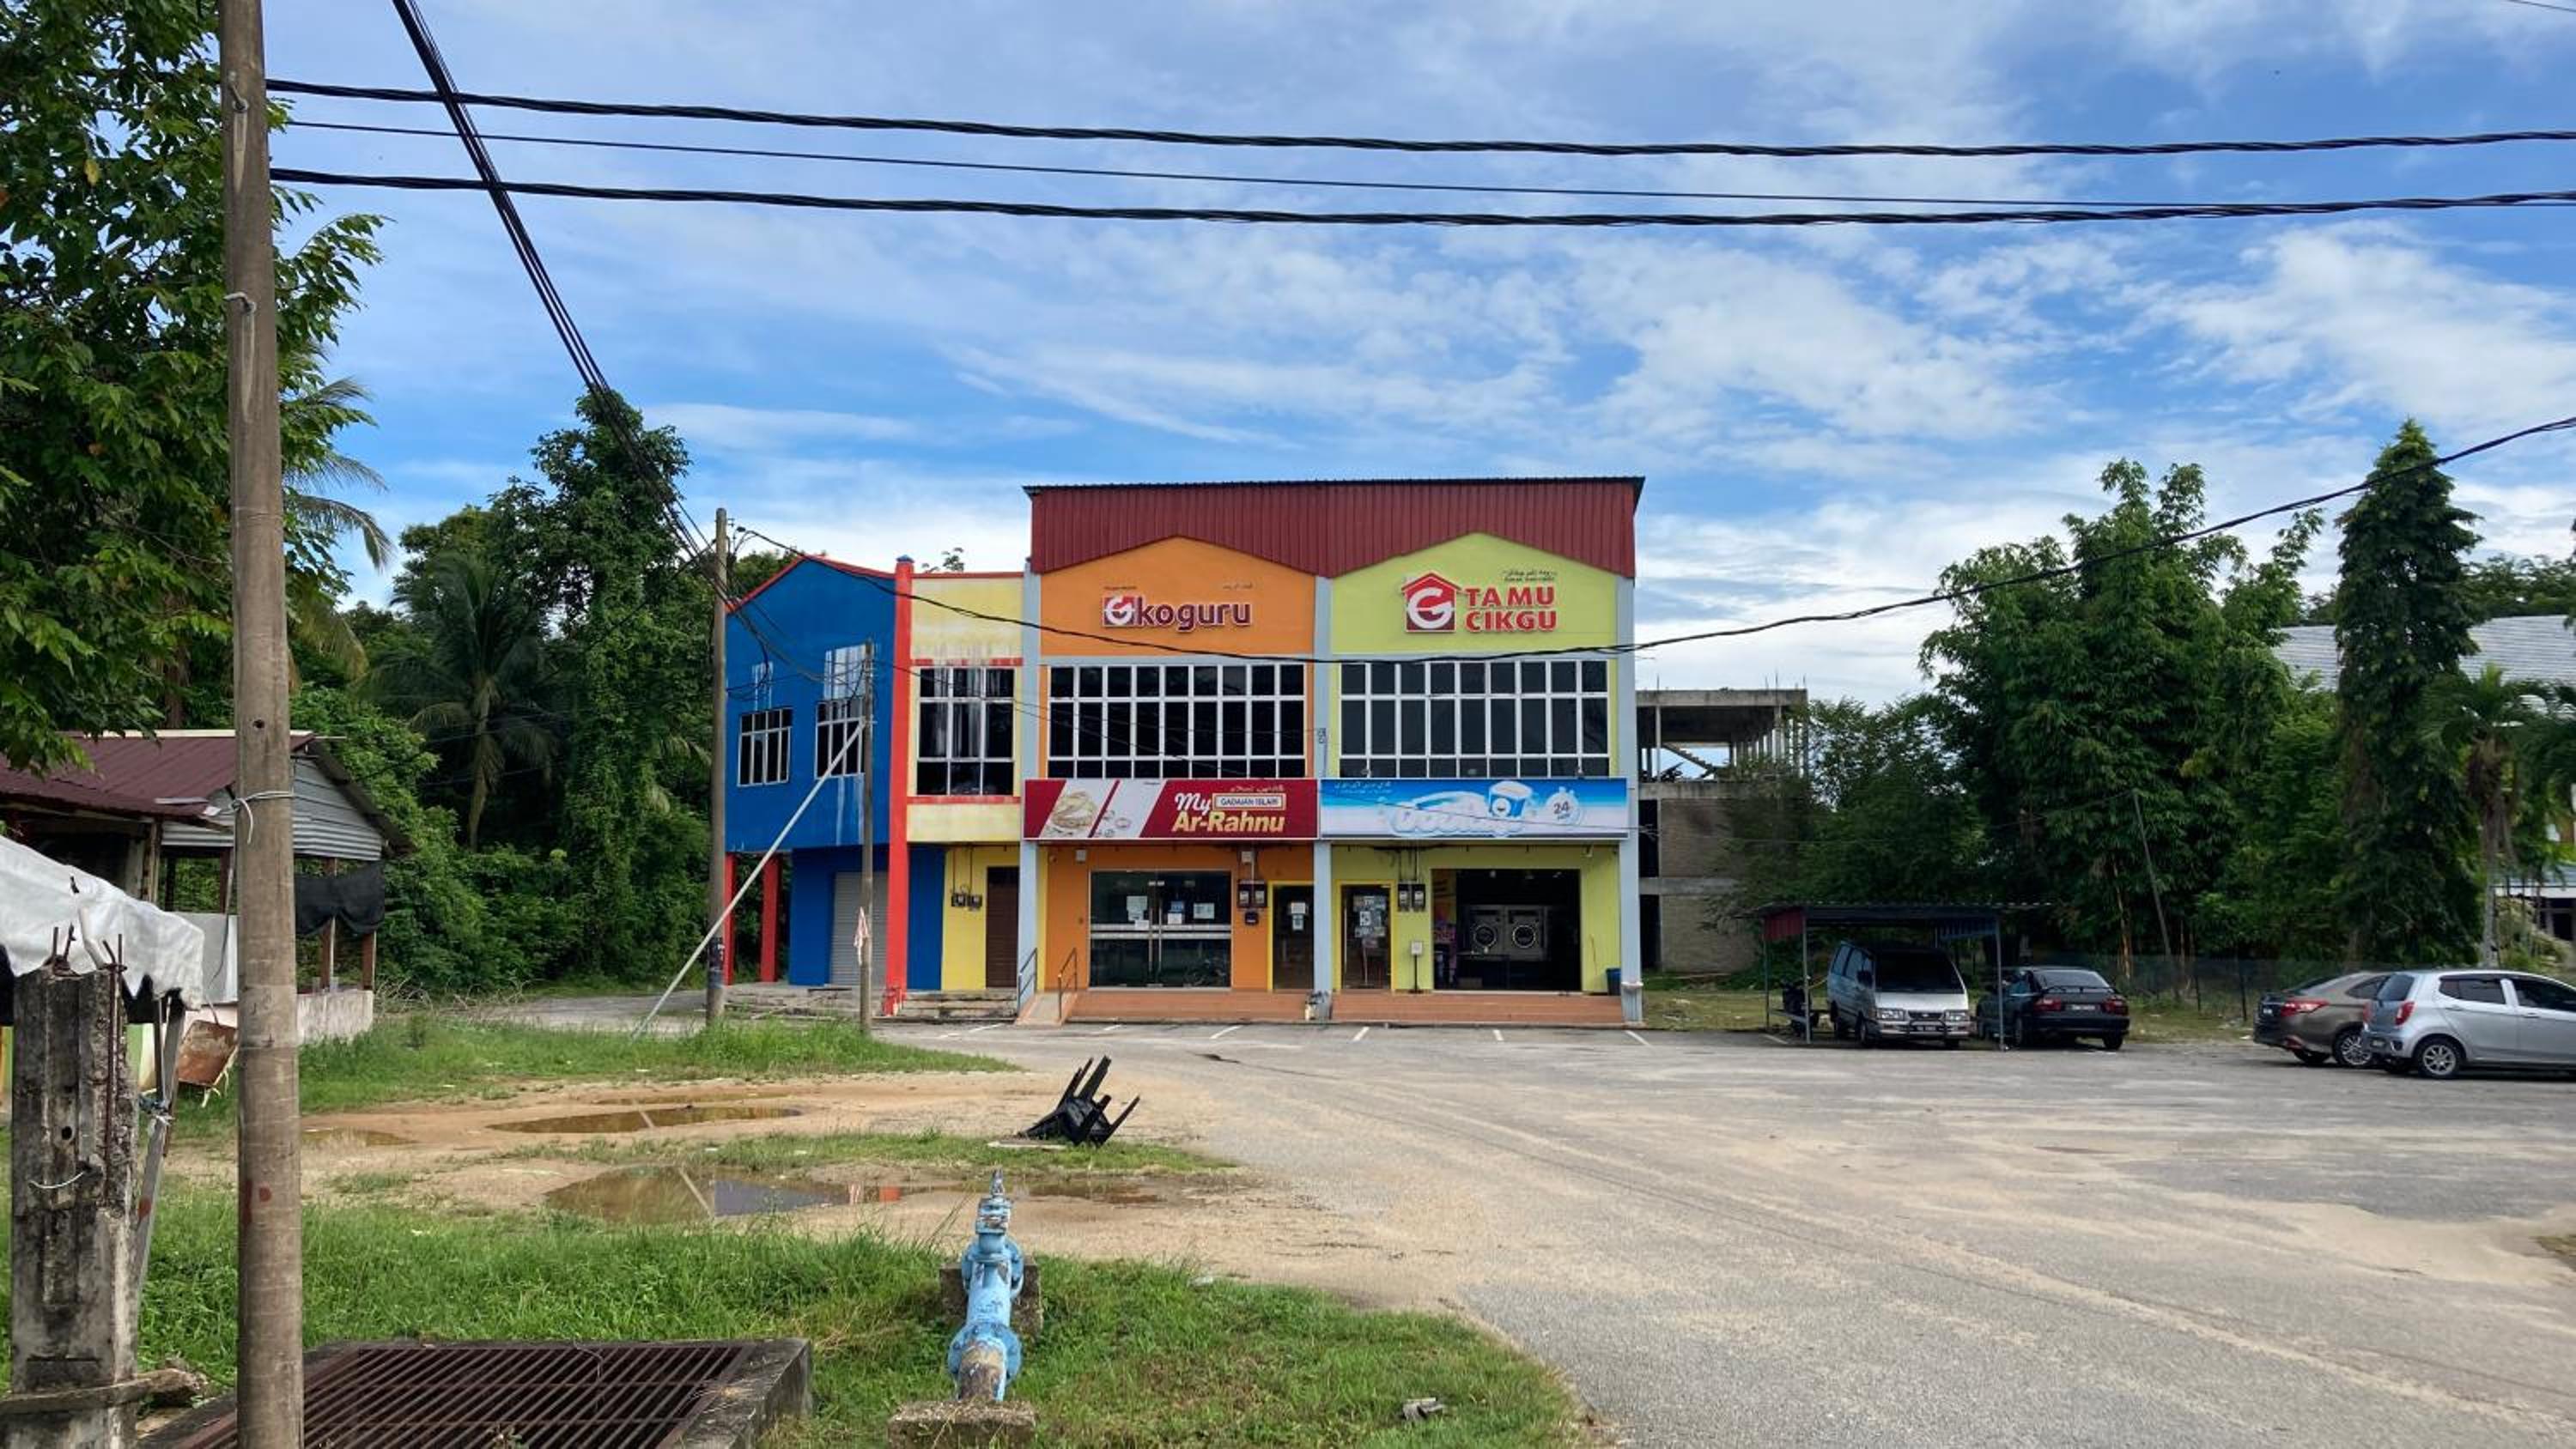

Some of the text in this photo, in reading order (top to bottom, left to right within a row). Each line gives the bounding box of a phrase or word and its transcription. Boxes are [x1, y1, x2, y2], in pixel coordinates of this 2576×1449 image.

[1465, 585, 1555, 607] TAMU
[1465, 609, 1558, 632] CIKGU
[1175, 792, 1212, 815] My
[1553, 801, 1570, 815] 24
[1171, 811, 1285, 833] Ar-Rahnu
